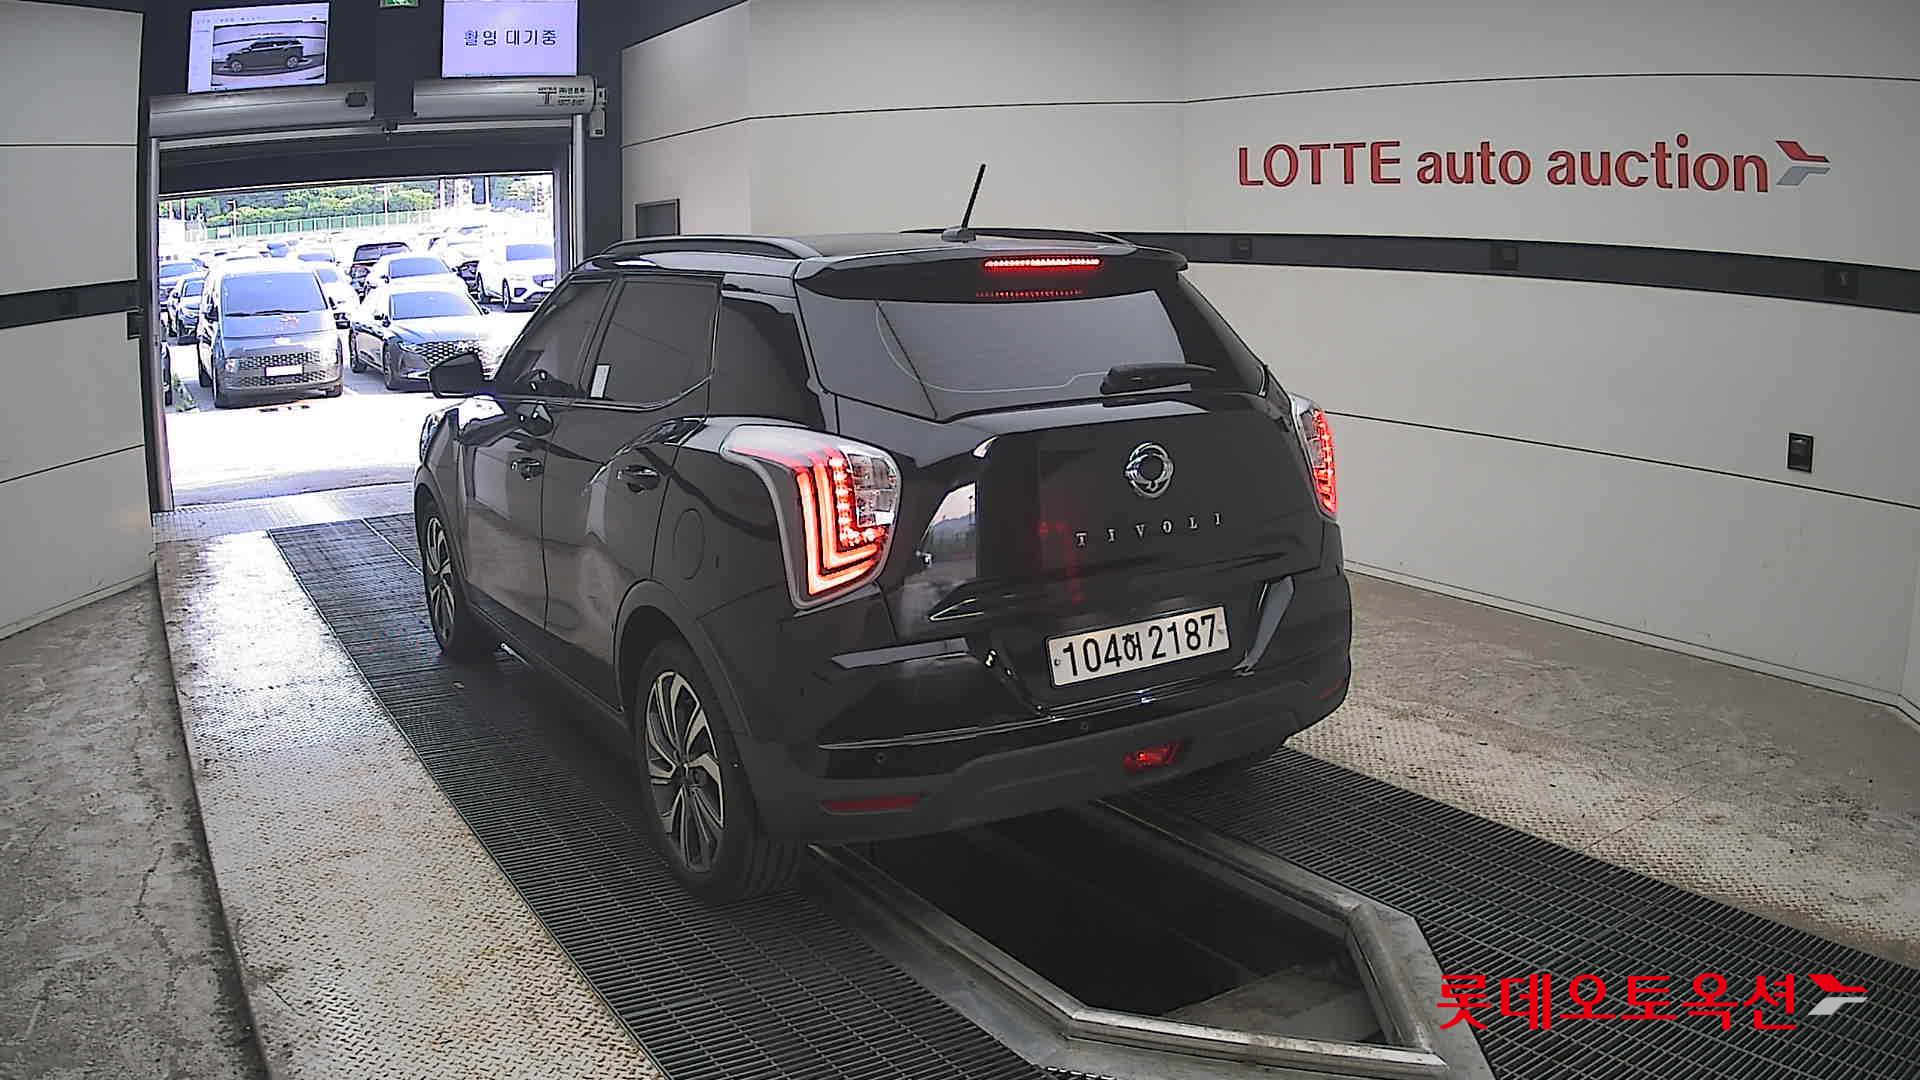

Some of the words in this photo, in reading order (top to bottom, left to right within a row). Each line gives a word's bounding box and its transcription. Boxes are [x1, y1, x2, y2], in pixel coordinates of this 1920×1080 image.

[505, 29, 558, 46] 대기중
[1238, 140, 1401, 187] LOTTE
[1415, 140, 1532, 187] auto
[1546, 133, 1770, 193] auction
[1075, 512, 1224, 547] TIVOLI
[1062, 632, 1144, 677] 104허
[1148, 613, 1217, 661] 2187
